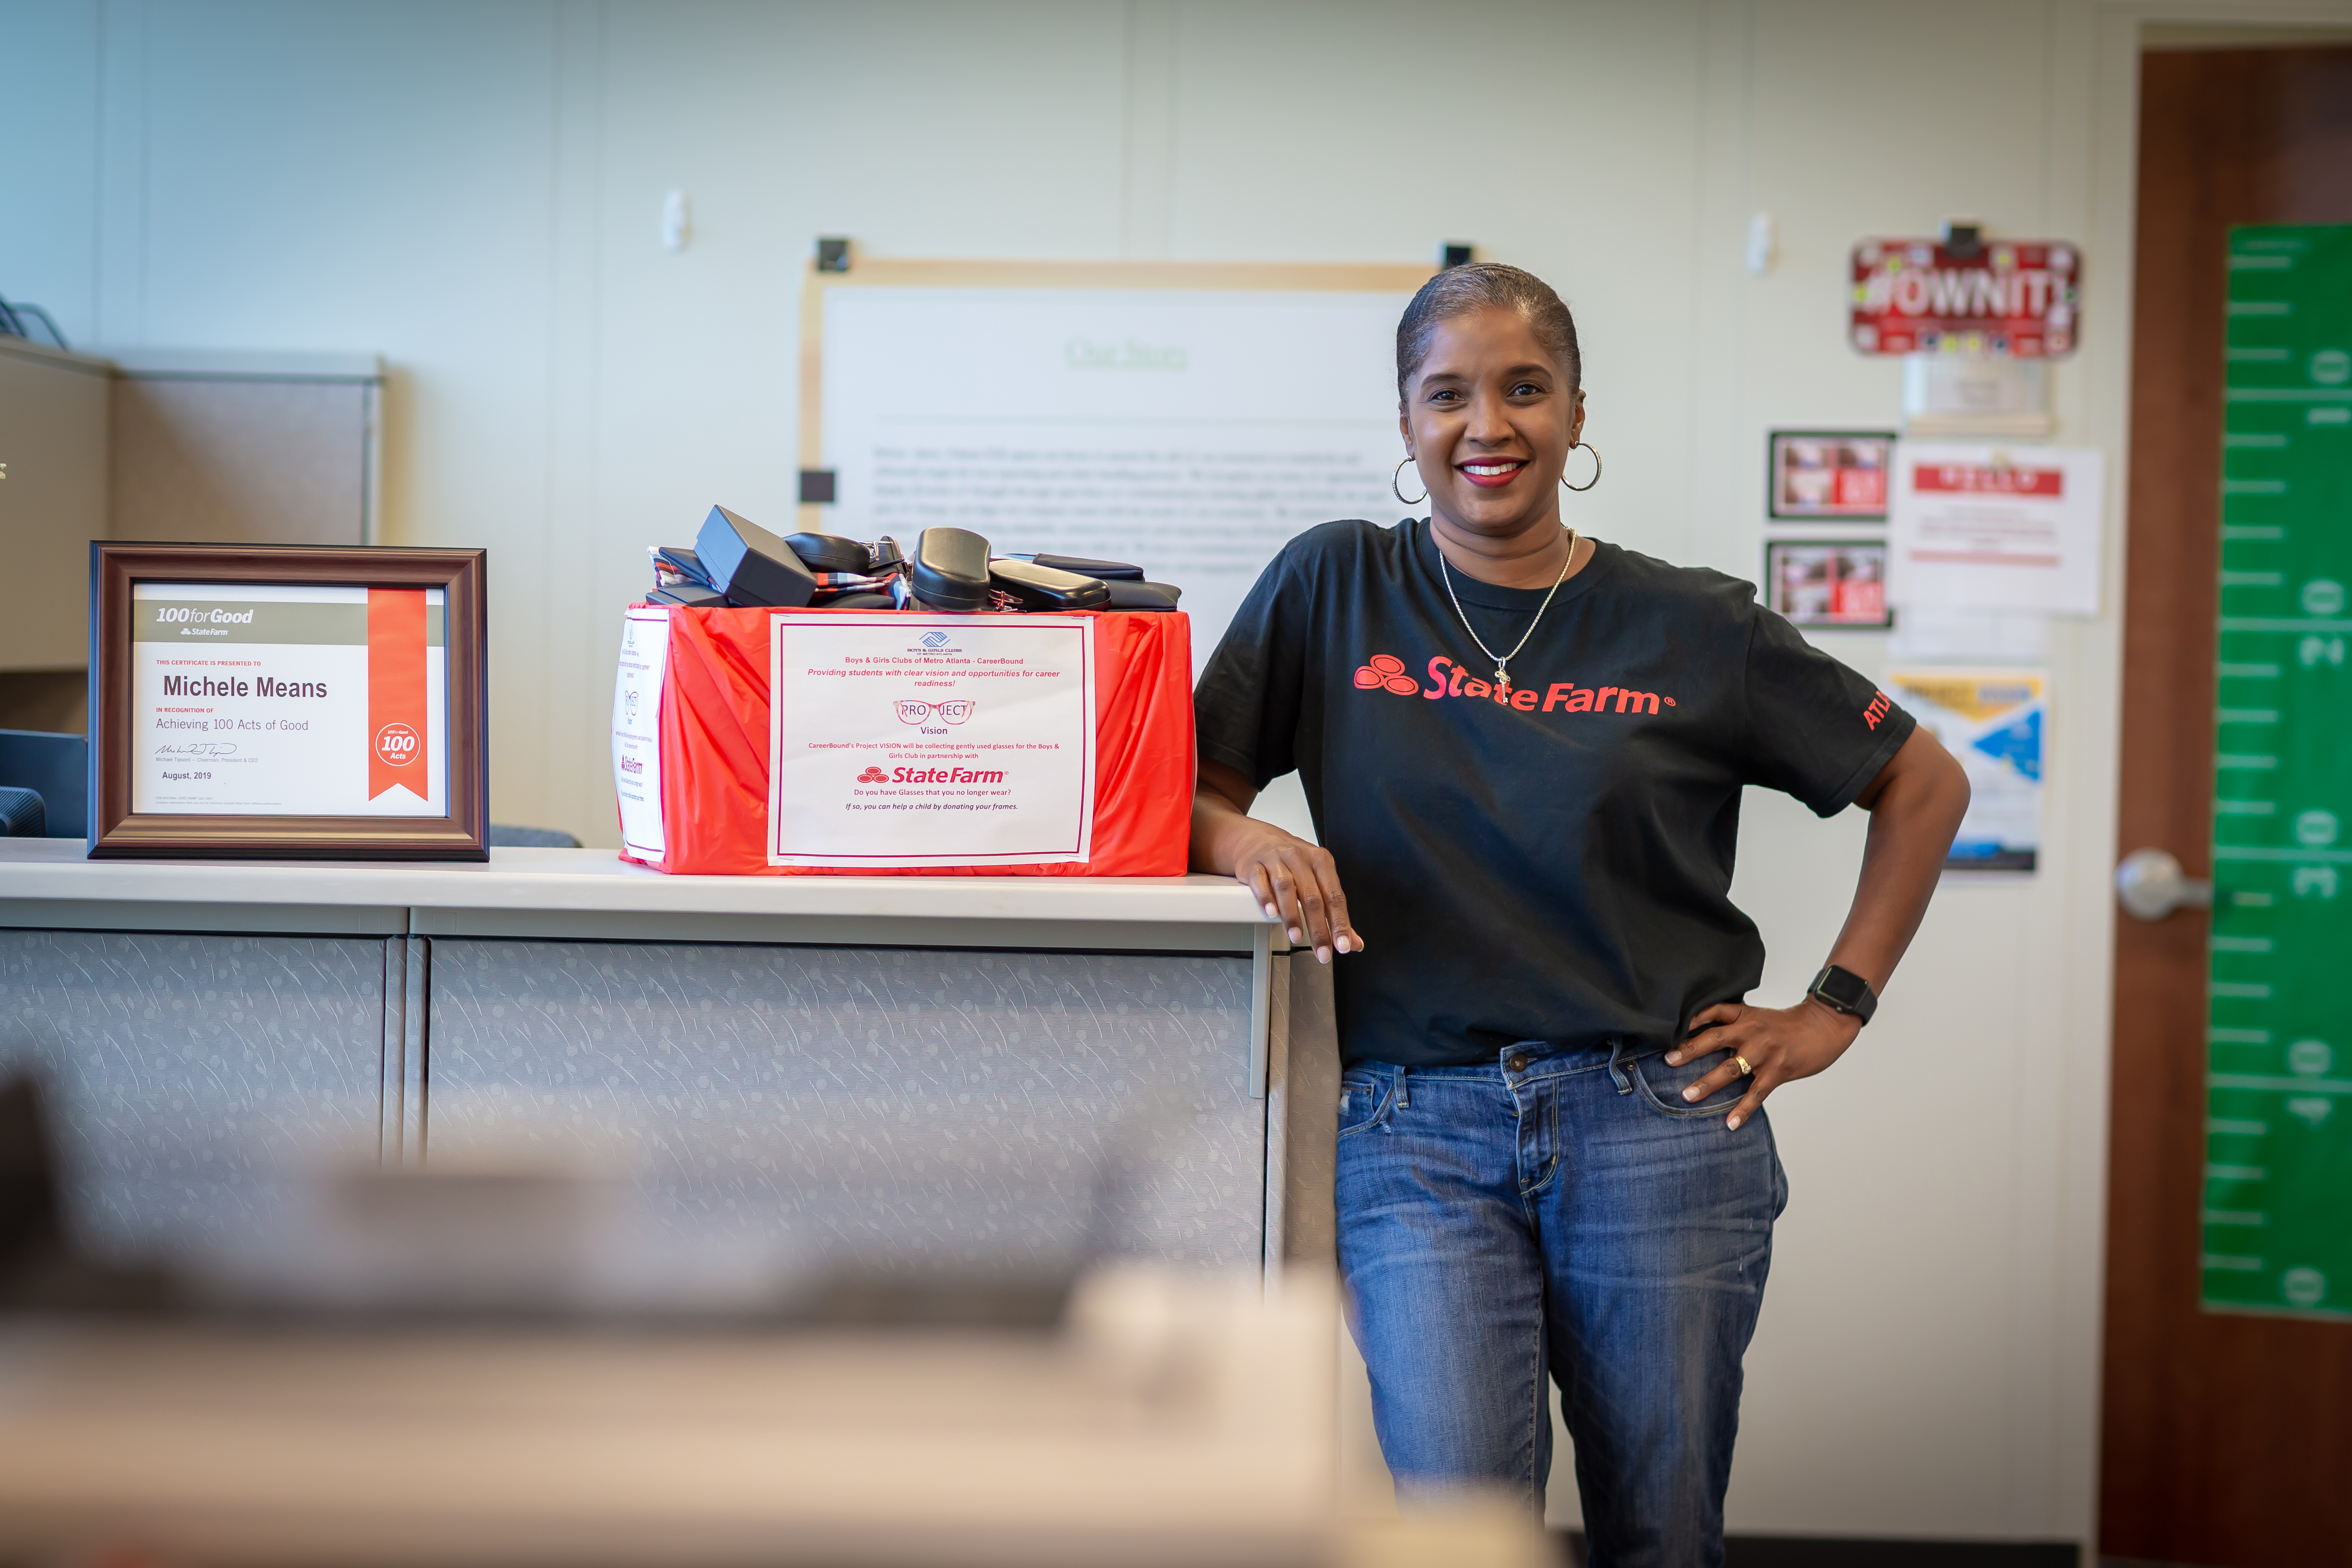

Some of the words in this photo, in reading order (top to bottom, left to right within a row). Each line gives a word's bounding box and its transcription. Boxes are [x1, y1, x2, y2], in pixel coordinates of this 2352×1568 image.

[156, 608, 253, 623] 100forGood
[808, 669, 846, 677] Providing
[968, 670, 1019, 678] opportunities
[164, 675, 248, 696] Michele
[257, 676, 327, 697] Means
[156, 718, 208, 731] Achieving
[214, 719, 233, 729] 100
[237, 719, 261, 730] Acts
[265, 720, 276, 730] of
[280, 720, 308, 730] Good
[381, 736, 415, 752] 100
[162, 771, 191, 780] August,
[990, 803, 1018, 811] frames.
